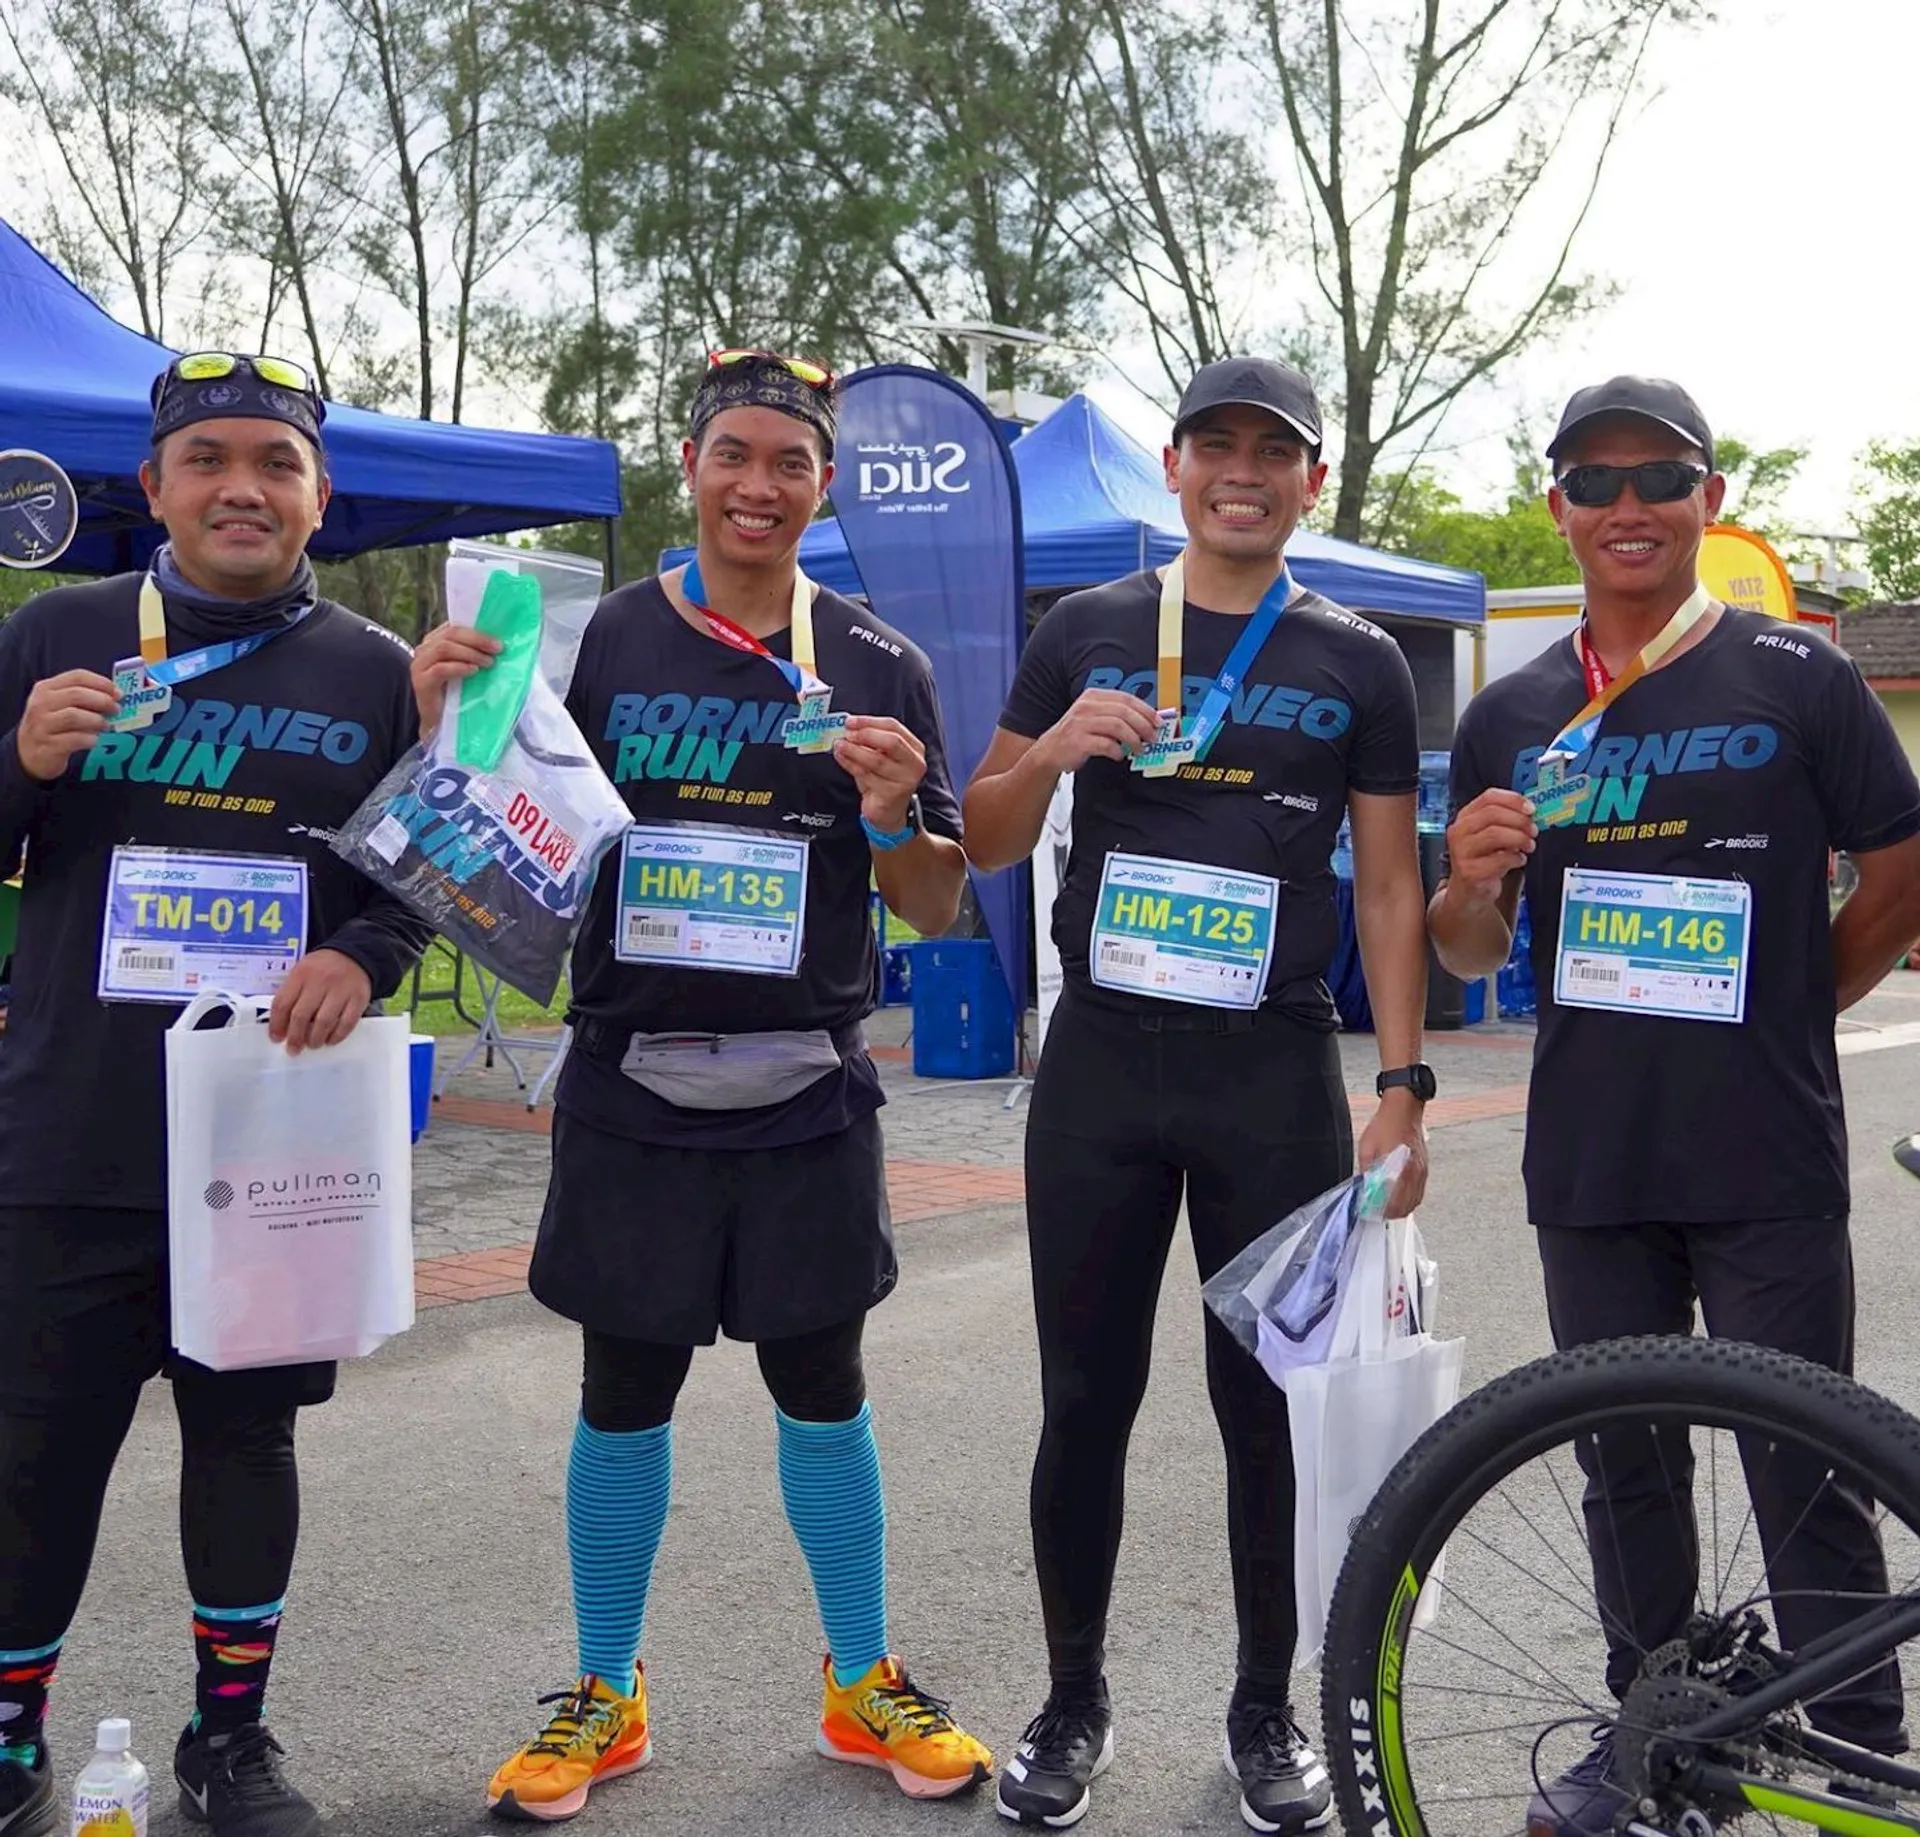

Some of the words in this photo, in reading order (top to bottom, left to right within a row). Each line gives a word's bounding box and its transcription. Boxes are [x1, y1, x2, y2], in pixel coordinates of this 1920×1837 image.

[1325, 610, 1382, 641] PRIME
[849, 624, 903, 658] PRIME
[1753, 634, 1811, 659] PRIME
[139, 698, 370, 765] ORNEO
[785, 716, 846, 733] BORNEO
[614, 733, 744, 784] RUN
[1143, 740, 1194, 755] ORNEO
[82, 731, 246, 790] RUN
[1177, 763, 1201, 781] run
[1204, 768, 1224, 782] as
[1224, 768, 1254, 785] one
[164, 789, 191, 806] we
[191, 791, 221, 810] run
[223, 793, 243, 812] as
[245, 796, 276, 815] one
[678, 783, 702, 800] we
[702, 786, 724, 802] run
[725, 790, 745, 803] as
[746, 790, 773, 806] one
[1587, 826, 1610, 843] we
[1611, 824, 1636, 842] run
[1636, 823, 1658, 839] as
[1658, 819, 1688, 836] one
[1725, 838, 1768, 849] BROOKS
[654, 842, 703, 854] BROOKS
[144, 869, 198, 882] BROOKS
[639, 864, 785, 908] HM-135
[1130, 871, 1176, 885] BROOKS
[1595, 887, 1643, 899] BROOKS
[130, 892, 284, 934] TM-014
[1113, 891, 1256, 944] HM-125
[1580, 908, 1725, 953] HM-146
[248, 1172, 381, 1200] pullman
[76, 1811, 121, 1824] WATER
